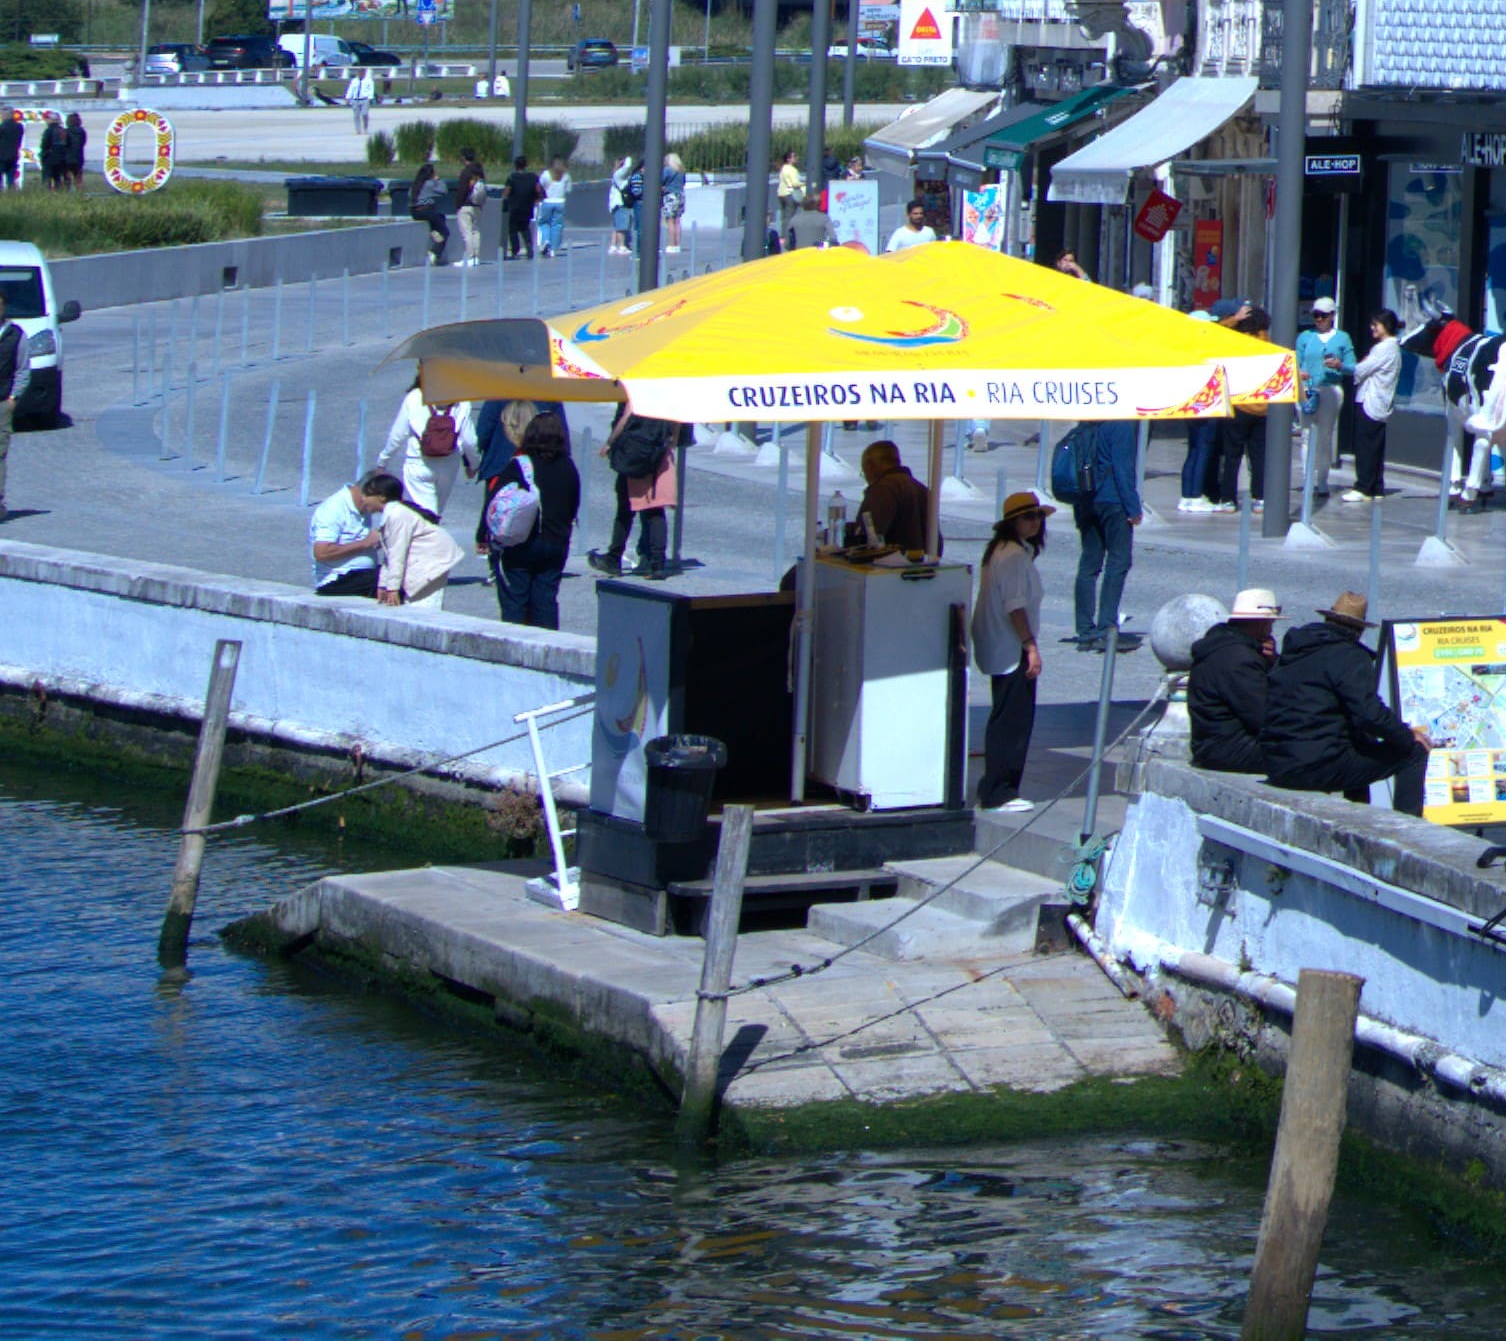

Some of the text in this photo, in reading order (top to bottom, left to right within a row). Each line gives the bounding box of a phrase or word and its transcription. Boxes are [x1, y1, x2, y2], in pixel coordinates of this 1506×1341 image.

[728, 381, 1119, 408] CRUZEIROS NA RIA RIA CRUISES
[1422, 626, 1466, 635] CRUZEIROS
[1480, 625, 1493, 633] RIA
[1437, 636, 1480, 645] RIA CRUISES
